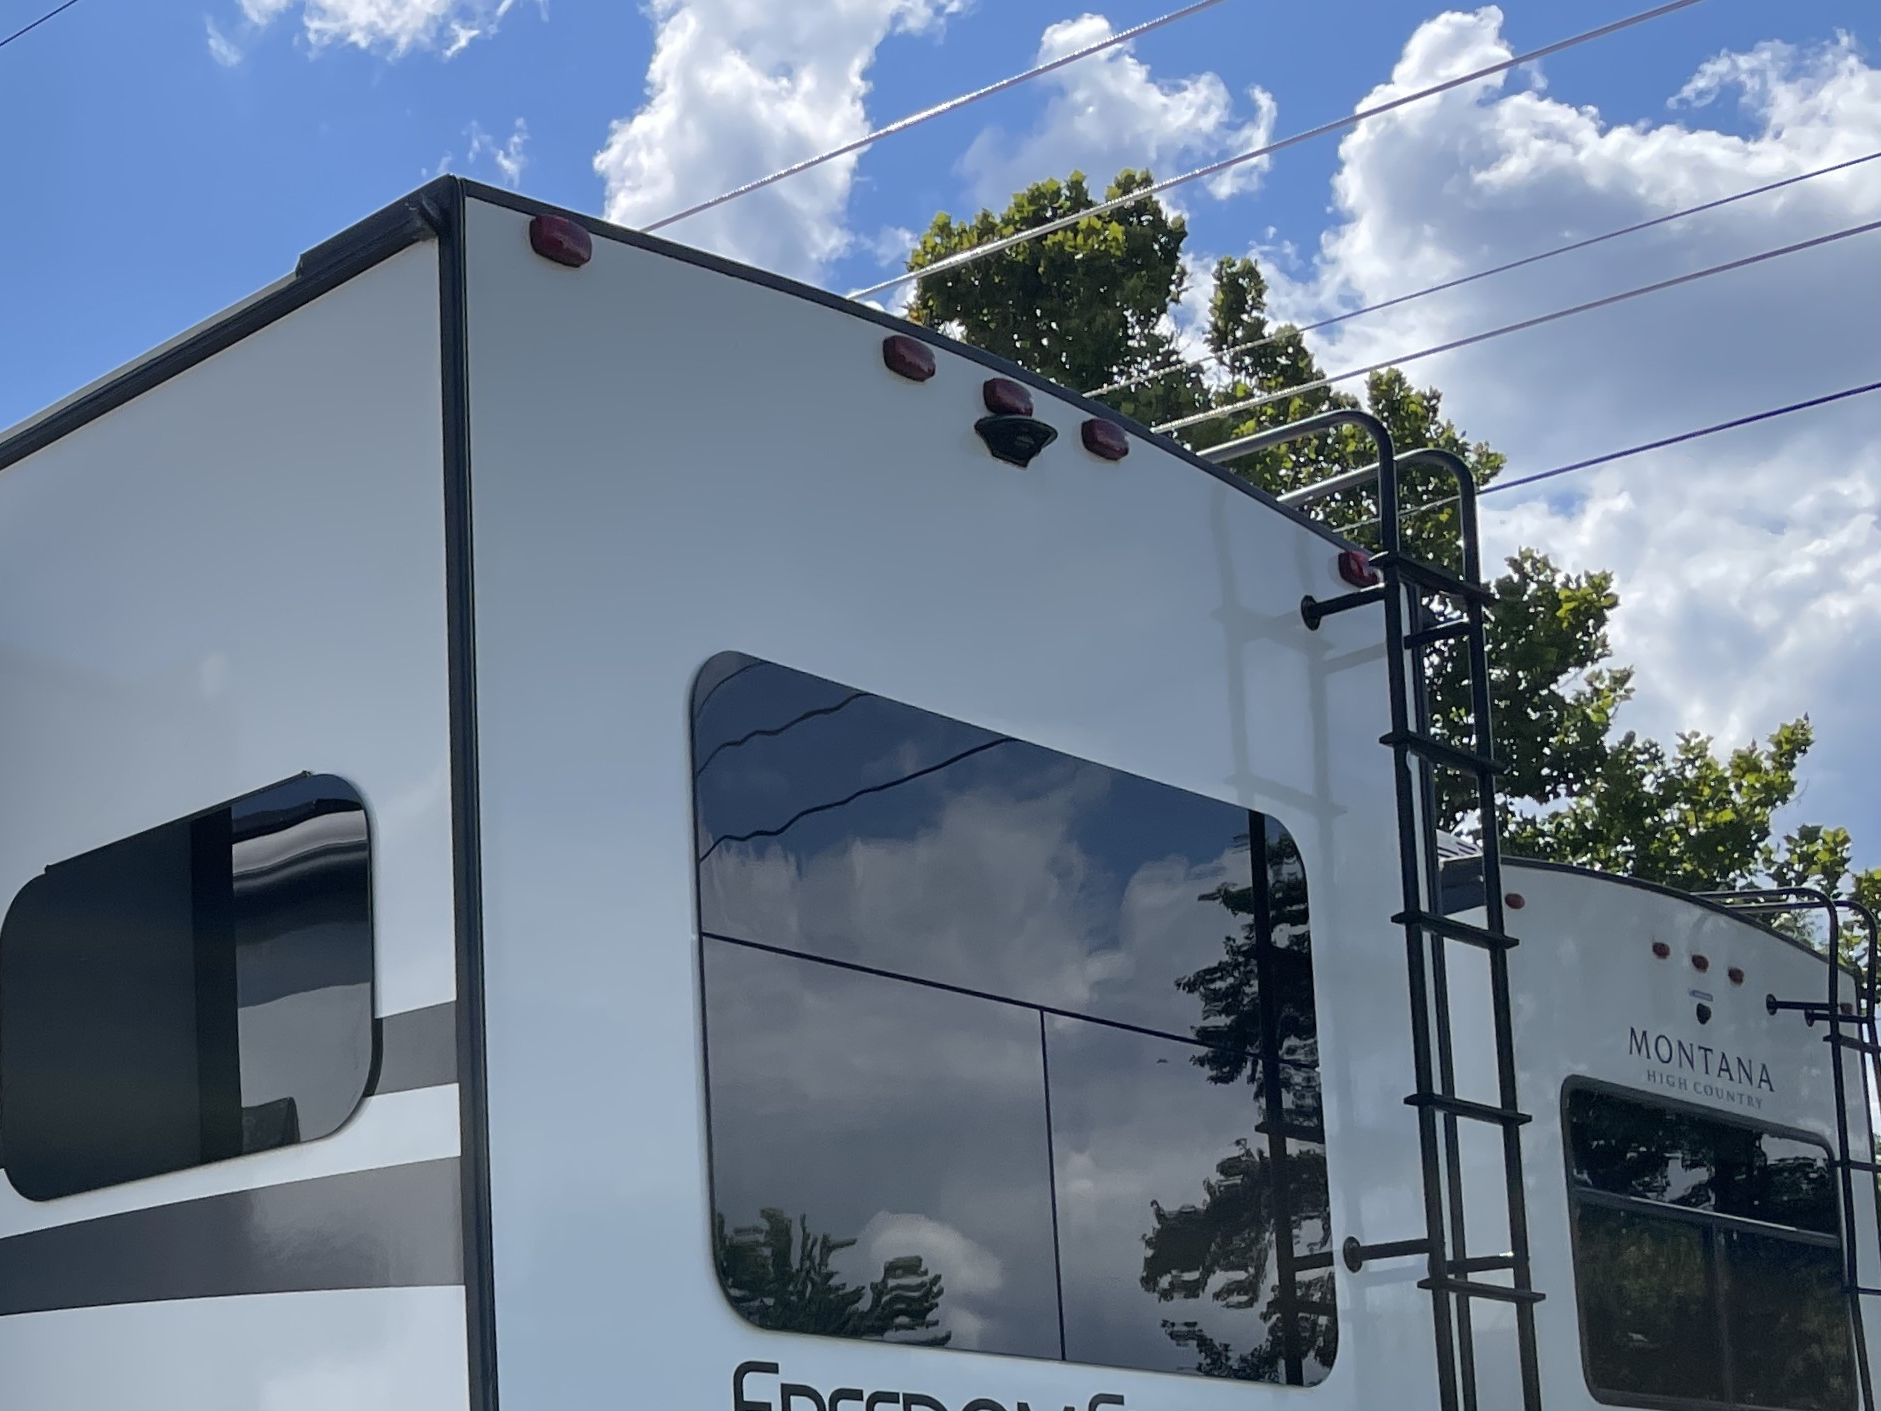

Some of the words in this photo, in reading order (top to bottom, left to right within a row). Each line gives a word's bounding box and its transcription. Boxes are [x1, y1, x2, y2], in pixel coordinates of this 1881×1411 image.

[1629, 1026, 1775, 1092] MONTANA
[1646, 1068, 1688, 1091] HIGH
[1693, 1081, 1763, 1110] COUNTRY
